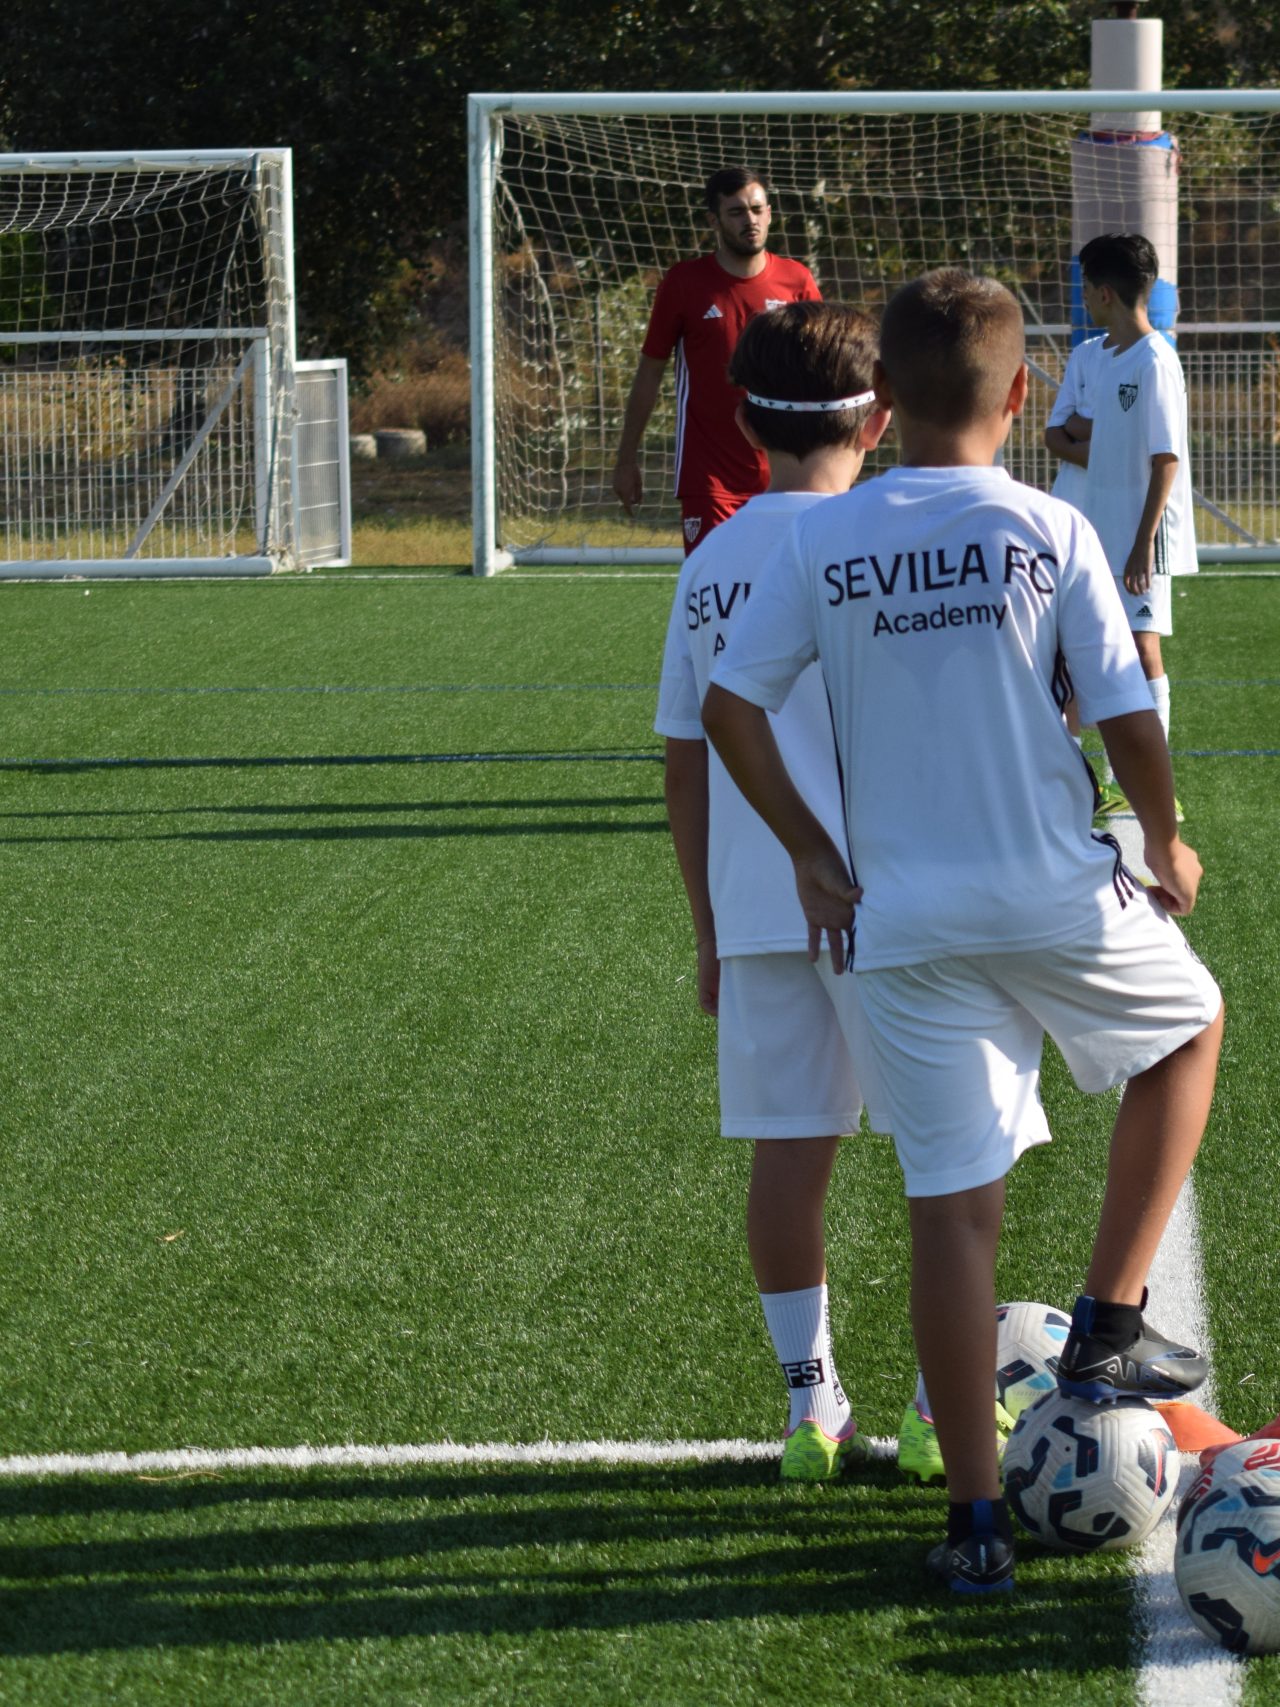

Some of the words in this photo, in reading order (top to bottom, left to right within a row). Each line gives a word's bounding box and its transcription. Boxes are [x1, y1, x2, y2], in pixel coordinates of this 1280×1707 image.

[824, 543, 990, 606] SEVILLA
[1003, 545, 1058, 594] FC
[873, 603, 1008, 638] Academy
[785, 1361, 822, 1387] FS
